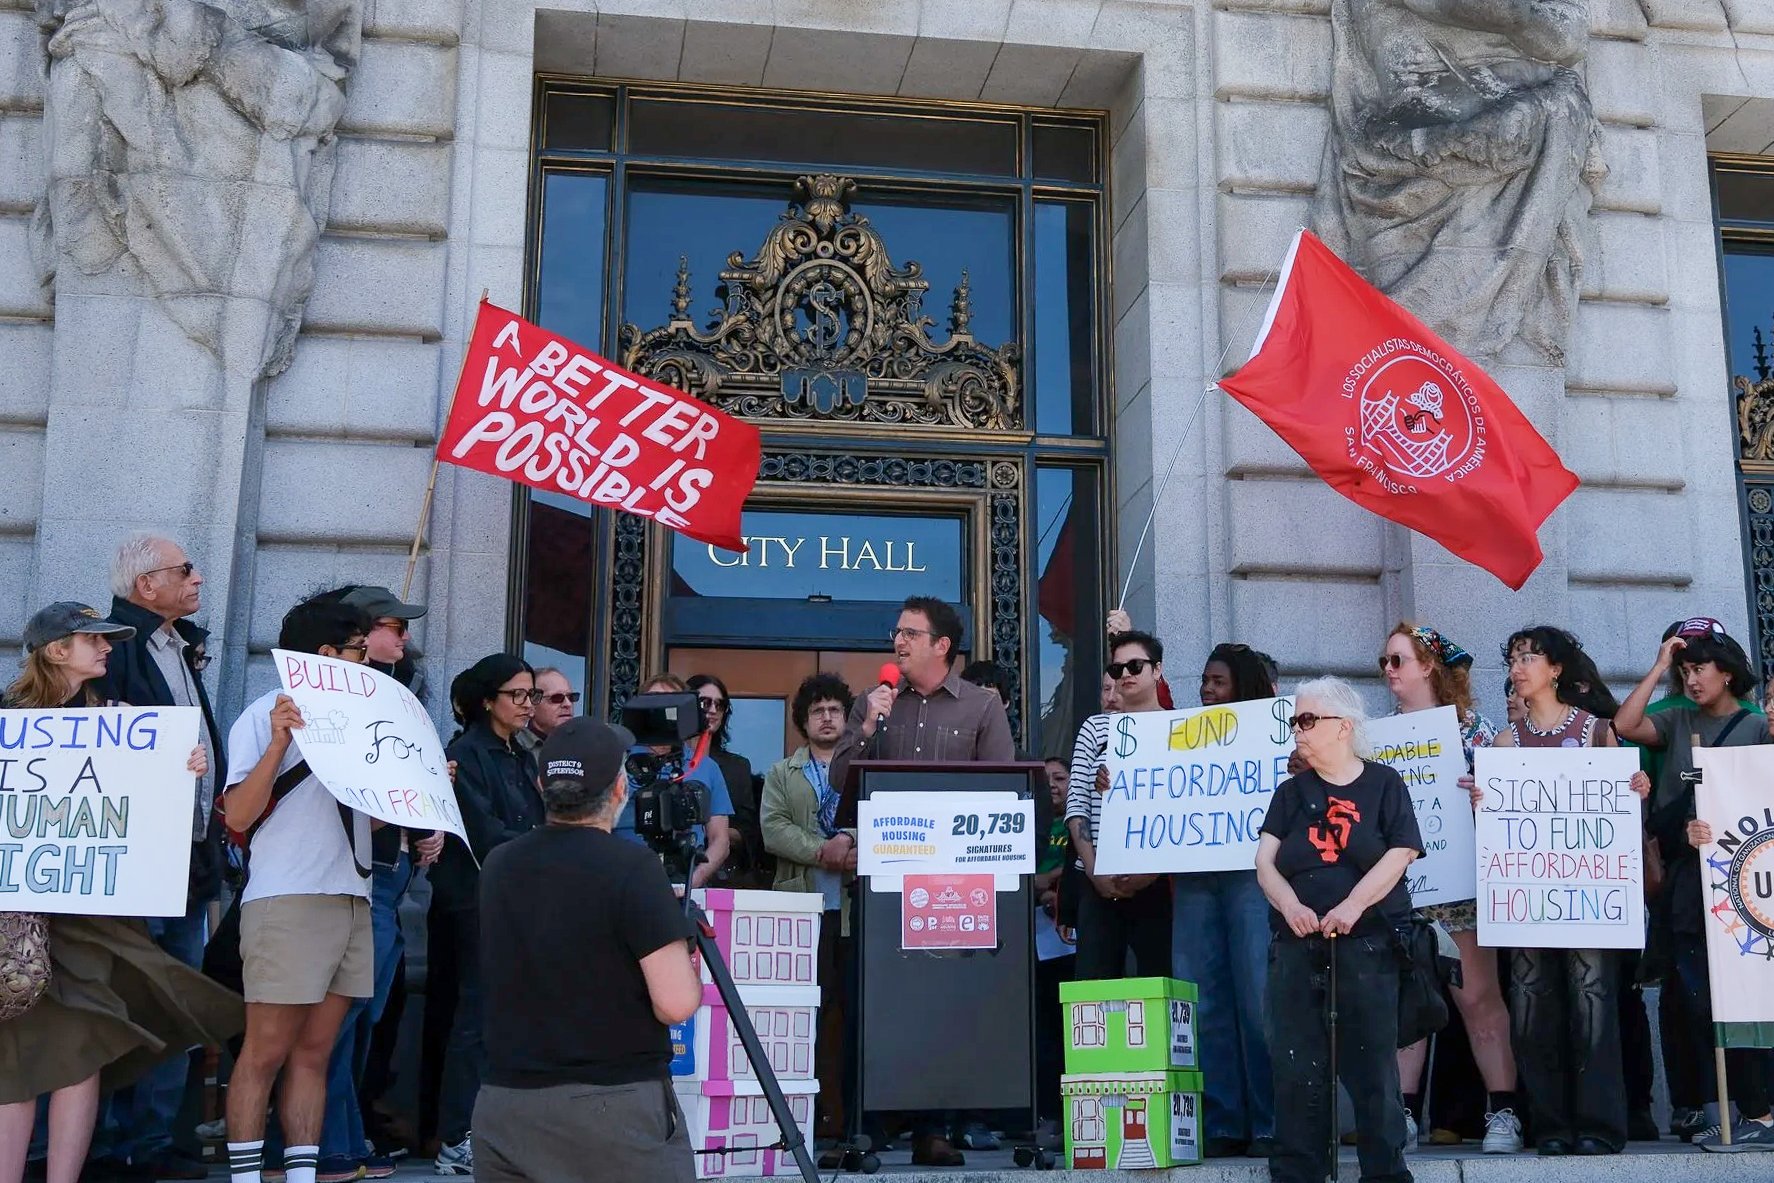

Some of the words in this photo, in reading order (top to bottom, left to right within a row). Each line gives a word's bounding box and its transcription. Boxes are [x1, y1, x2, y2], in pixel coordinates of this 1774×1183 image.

[1351, 338, 1411, 379] SOCIALISTAS
[492, 320, 522, 357] A
[528, 340, 720, 461] BETTER
[1341, 375, 1357, 399] LOS
[1409, 340, 1481, 414] DEMOCRÁTICOS
[477, 356, 640, 468] WORLD
[649, 459, 714, 513] IS
[1474, 416, 1486, 434] DE
[451, 411, 692, 528] POSSIBLE
[1345, 426, 1357, 458] SAN
[1356, 455, 1418, 494] FRANCISCO
[1444, 436, 1486, 483] AMÉRICA
[708, 536, 806, 568] CITY
[819, 536, 927, 572] HALL
[286, 656, 377, 698] BUILD
[1167, 712, 1239, 751] FUND
[0, 758, 48, 793] IS
[69, 756, 102, 793] A
[547, 767, 585, 777] SUPERVISOR
[548, 760, 577, 769] DISTRICT
[1107, 755, 1291, 804] AFFORDABLE
[1432, 797, 1442, 810] A
[1486, 777, 1558, 813] SIGN
[1569, 779, 1631, 813] HERE
[0, 795, 129, 839] UMAN
[873, 816, 936, 829] AFFORDABLE
[952, 812, 1025, 841] 20,739
[1125, 808, 1262, 849] HOUSING
[1497, 817, 1538, 850] TO
[1551, 817, 1615, 850] FUND
[873, 844, 936, 856] GUARANTEED
[882, 831, 926, 842] HOUSING
[966, 844, 1013, 855] SIGNATURES
[967, 855, 1001, 863] AFFORDABLE
[1002, 854, 1027, 862] HOUSING
[1487, 851, 1630, 881] AFFORDABLE
[1491, 888, 1623, 922] HOUSING
